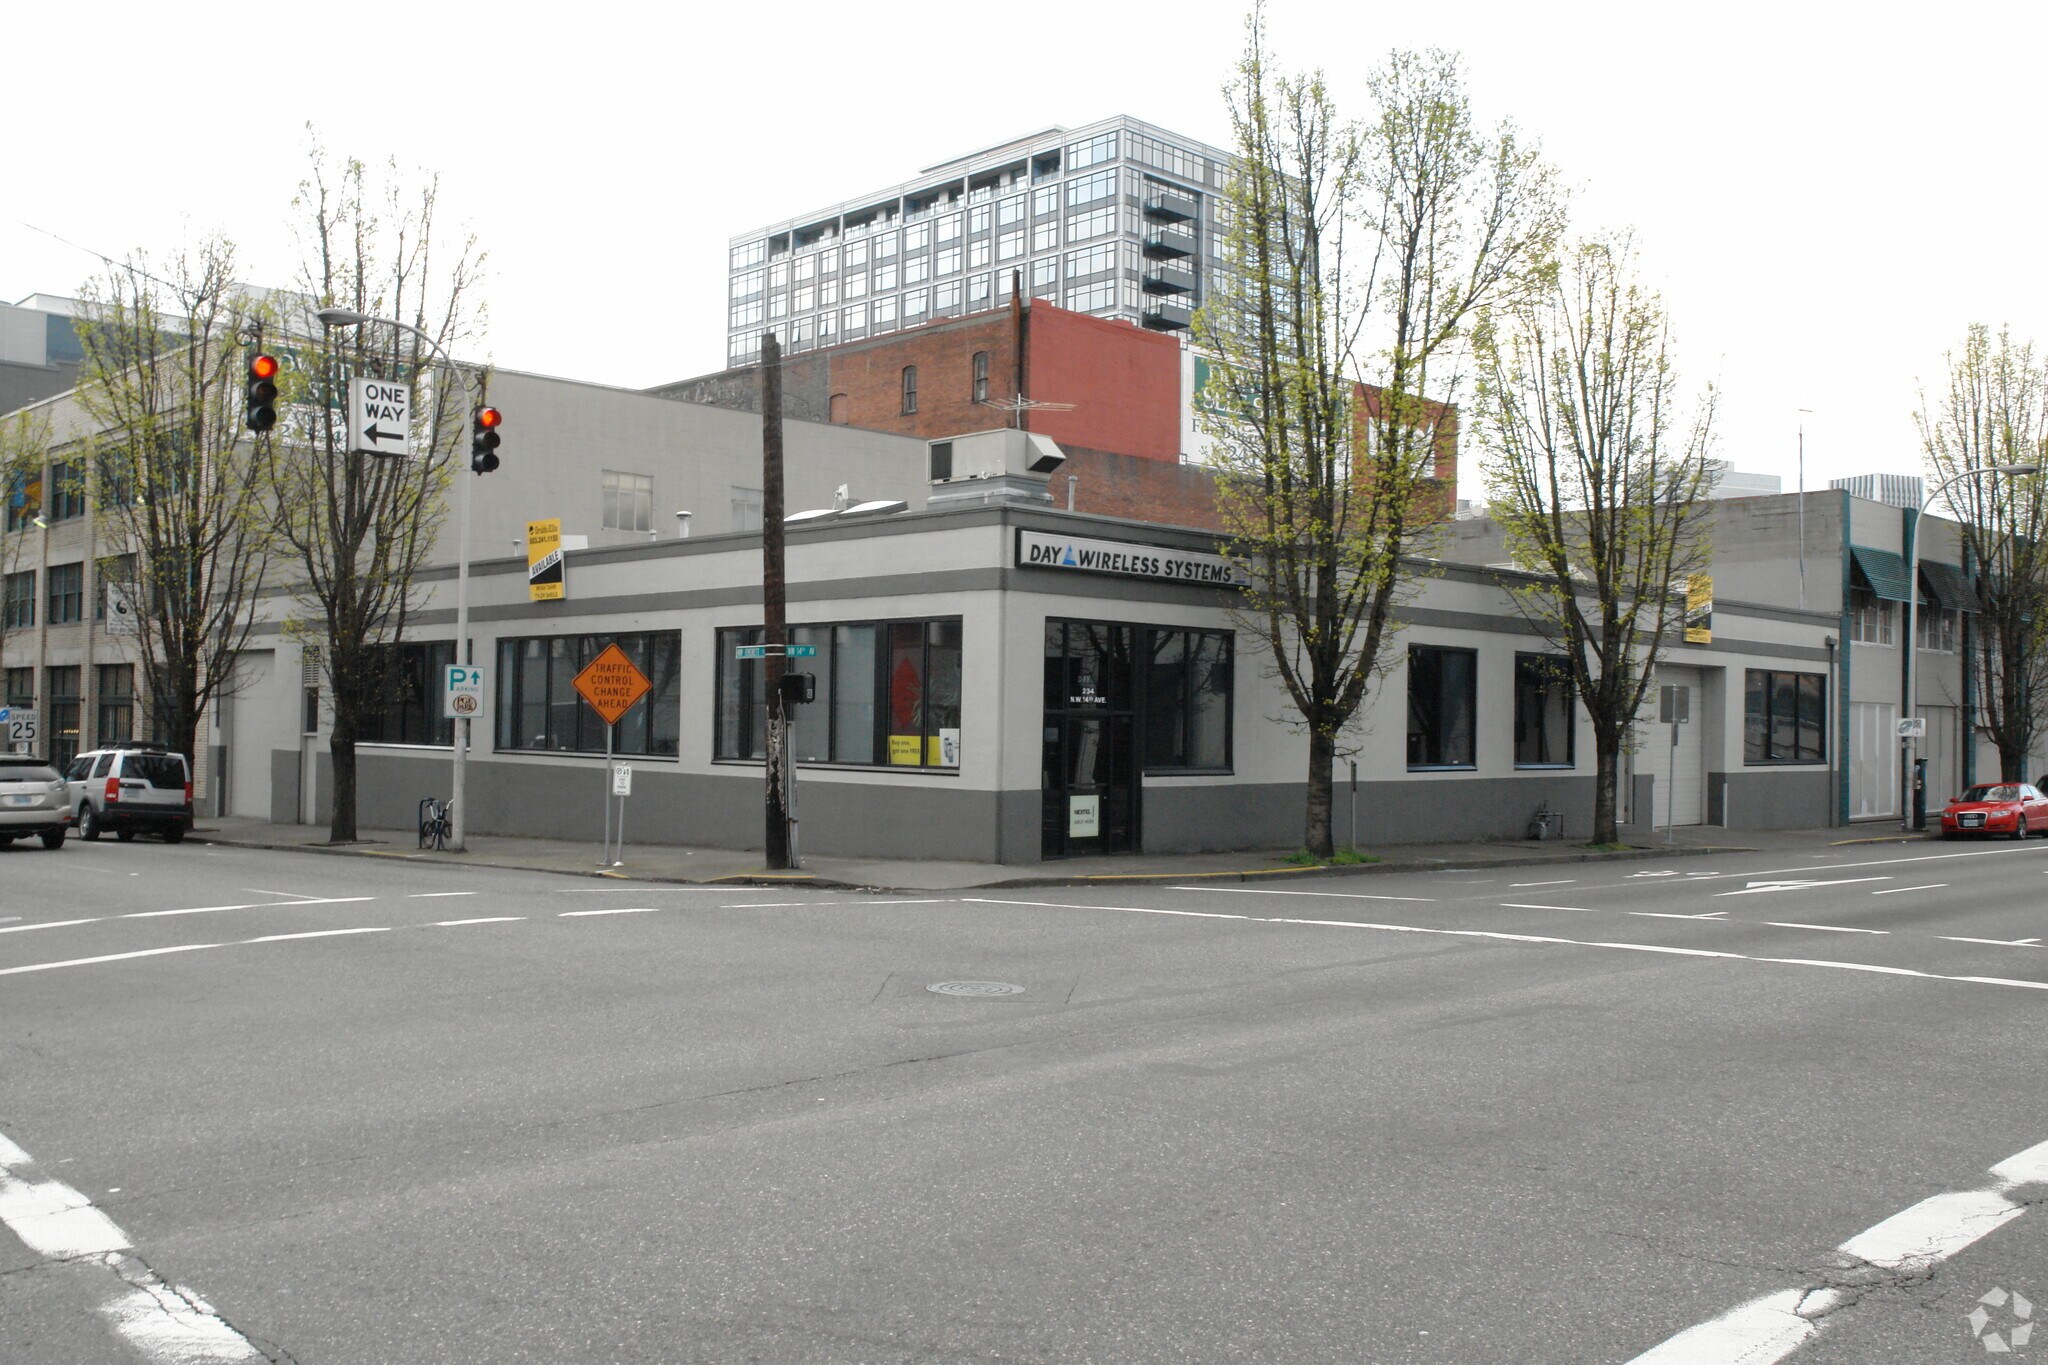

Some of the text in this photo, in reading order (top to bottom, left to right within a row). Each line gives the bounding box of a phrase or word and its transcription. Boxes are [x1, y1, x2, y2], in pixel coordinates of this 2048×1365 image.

[365, 384, 404, 404] ONE
[365, 403, 405, 422] WAY
[531, 550, 560, 577] AVAILABLE
[1030, 544, 1232, 583] DAY WIRELESS SYSTEMS
[595, 664, 632, 674] TRAFFIC
[591, 675, 634, 686] CONTROL
[594, 687, 631, 697] CHANGE
[597, 699, 628, 709] AHEAD
[12, 721, 36, 739] 25
